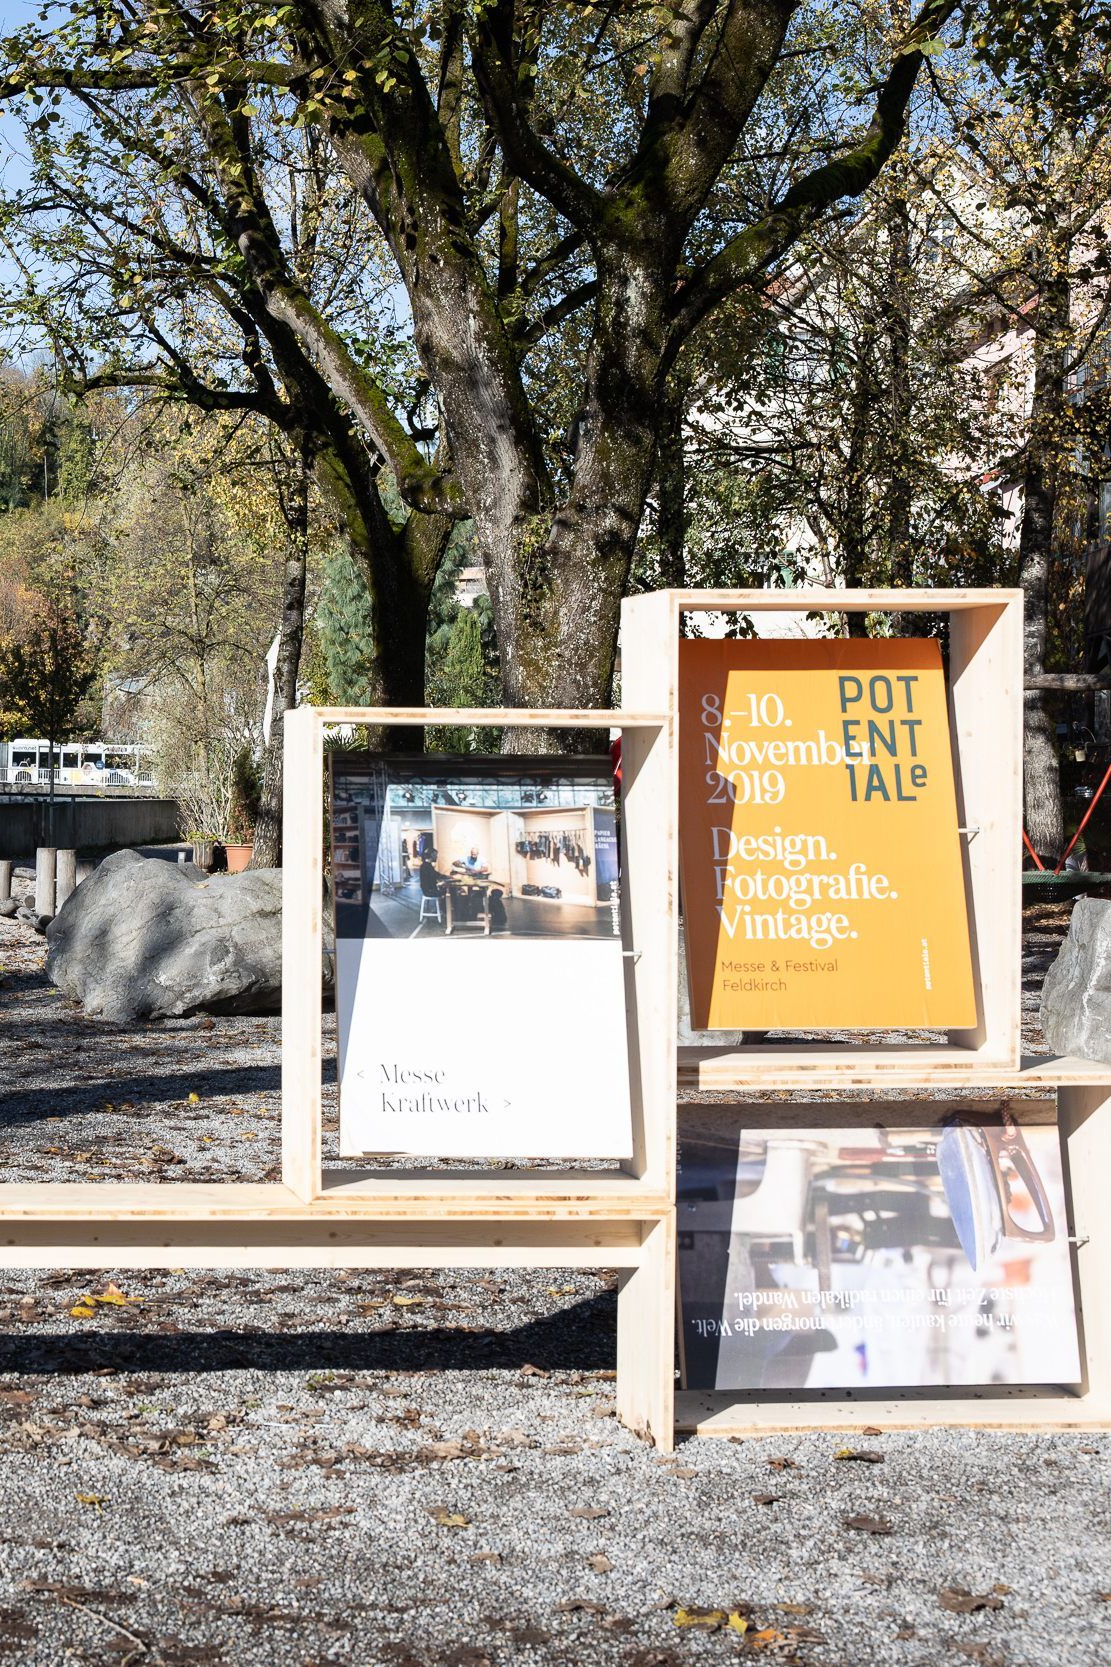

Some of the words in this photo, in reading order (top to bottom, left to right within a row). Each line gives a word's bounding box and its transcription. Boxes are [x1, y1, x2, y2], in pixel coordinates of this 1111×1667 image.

[838, 674, 919, 714] POT
[703, 729, 877, 766] November
[842, 719, 923, 757] ENT
[705, 769, 786, 805] 2019
[711, 825, 837, 871] Design.
[714, 862, 898, 910] Fotografie.
[715, 903, 859, 950] Vintage.
[720, 960, 766, 973] Messe
[770, 959, 780, 972] &
[785, 958, 839, 972] Festival
[722, 978, 788, 992] Feldkirch
[380, 1063, 445, 1084] Messe
[381, 1091, 488, 1113] Kraftwerk
[733, 1290, 800, 1311] Wandel.
[802, 1288, 878, 1309] radikalen
[928, 1287, 951, 1307] für
[691, 1318, 732, 1337] Welt.
[735, 1317, 760, 1337] die
[762, 1312, 825, 1331] morgen
